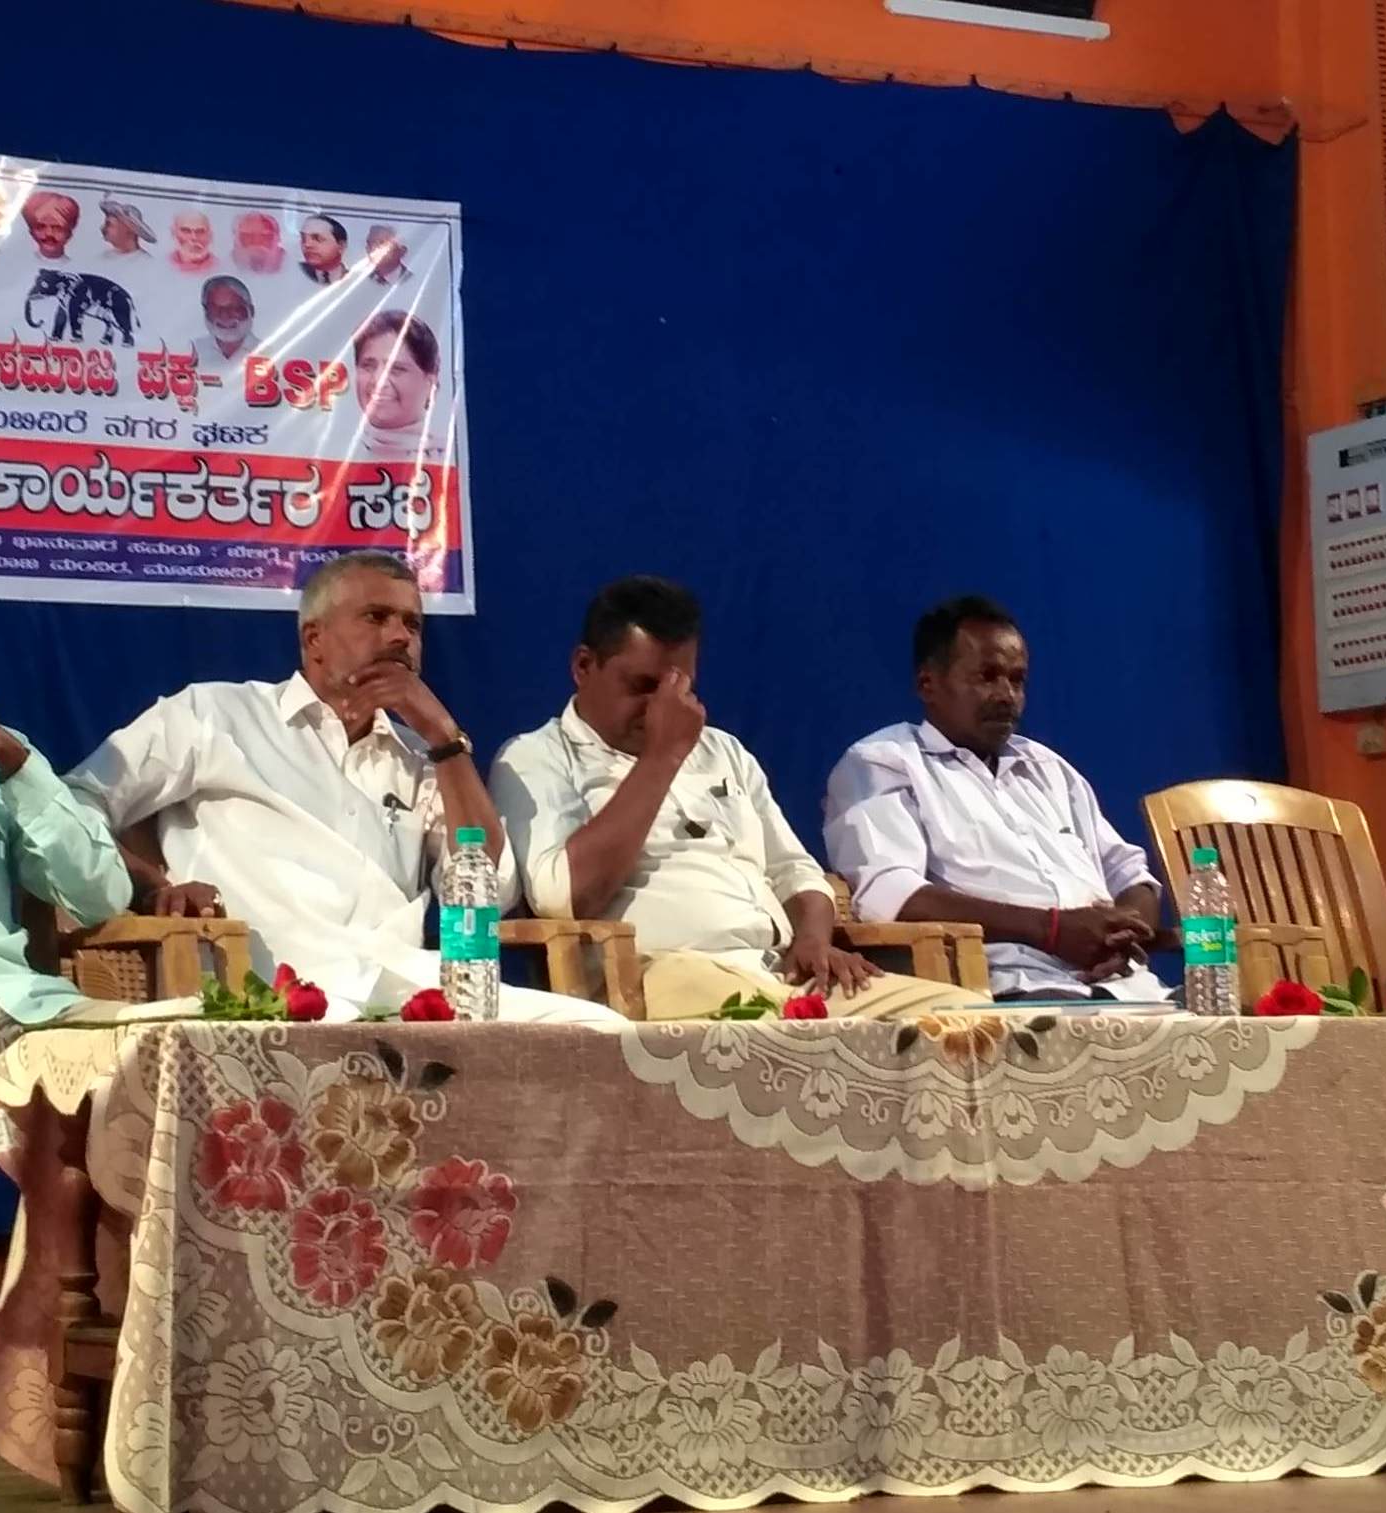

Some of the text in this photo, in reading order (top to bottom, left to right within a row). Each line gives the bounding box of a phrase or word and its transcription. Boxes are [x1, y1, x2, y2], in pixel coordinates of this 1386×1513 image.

[243, 355, 349, 410] BSP
[104, 414, 178, 440] ನಗರ
[192, 422, 268, 447] ಘಟಕ
